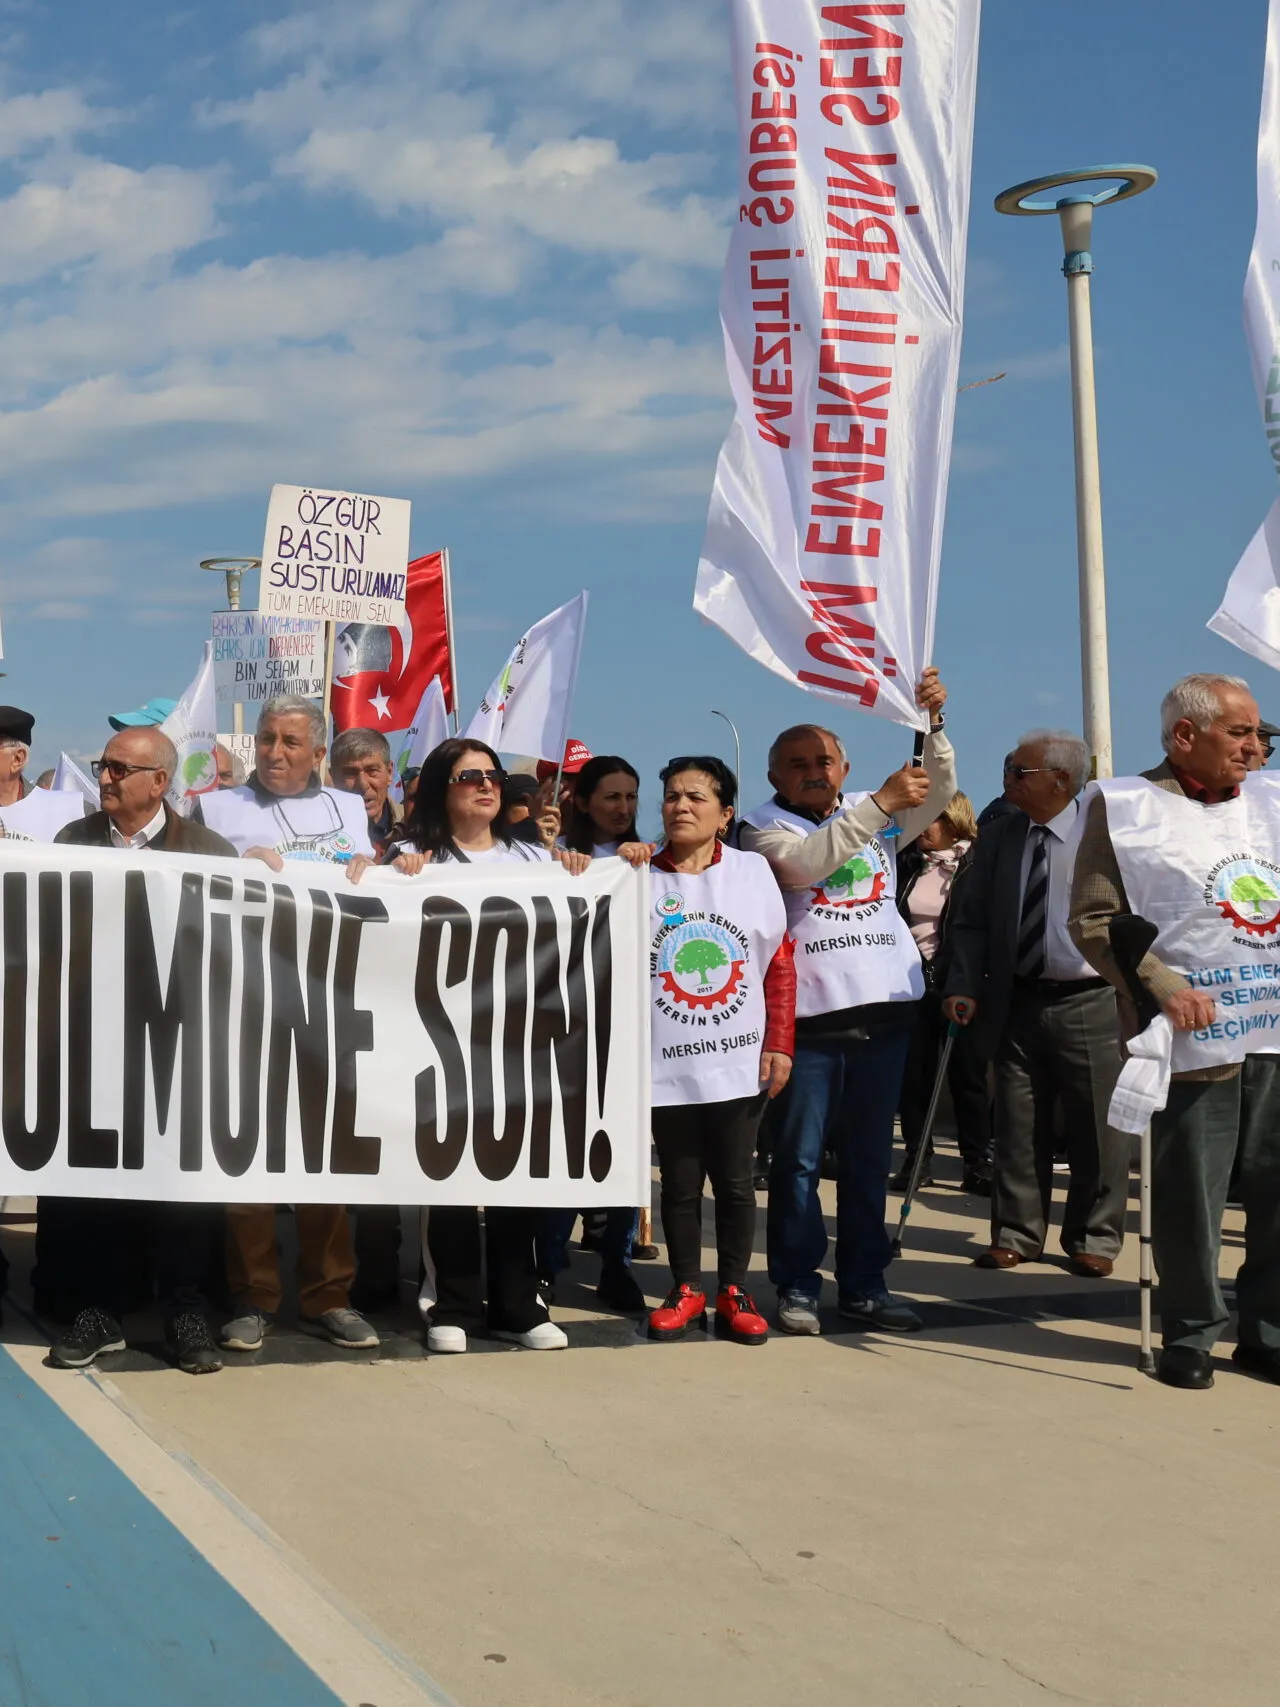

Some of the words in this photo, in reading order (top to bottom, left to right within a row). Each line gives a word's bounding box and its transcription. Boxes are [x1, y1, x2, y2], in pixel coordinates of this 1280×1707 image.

[298, 489, 382, 535] ÖZGÜR
[277, 525, 365, 564] BASIN
[269, 561, 406, 601] SUSTURULAMAZ
[268, 592, 291, 611] TÜM
[235, 660, 257, 682] BİN
[652, 911, 705, 949] EMEKERİN
[805, 933, 862, 955] MERSİN
[697, 986, 713, 994] 2017
[1184, 967, 1232, 989] TÜM
[655, 997, 707, 1026] MERSİN
[712, 984, 749, 1027] ŞUBESİ
[414, 894, 612, 1183] SON!
[662, 1038, 717, 1060] MERSİN
[721, 1027, 760, 1054] ŞUBESİ
